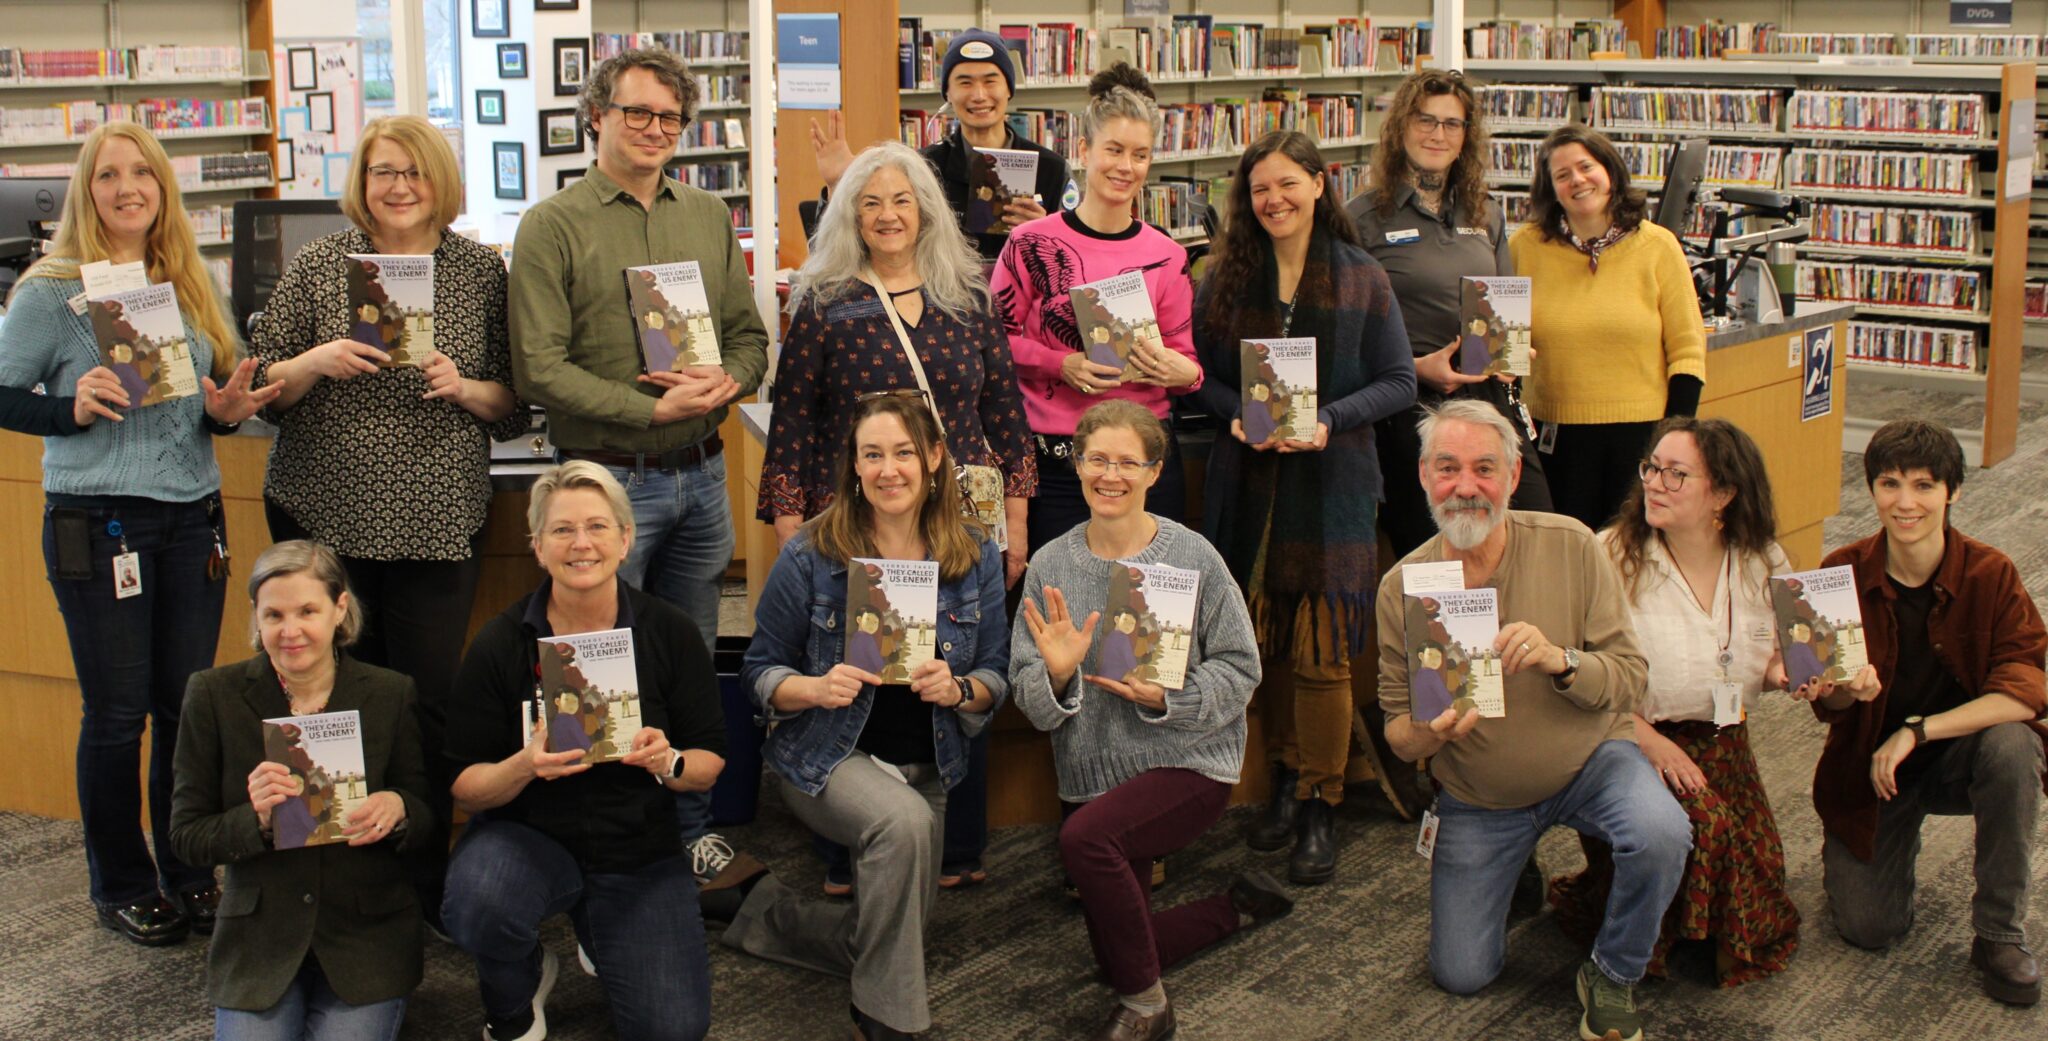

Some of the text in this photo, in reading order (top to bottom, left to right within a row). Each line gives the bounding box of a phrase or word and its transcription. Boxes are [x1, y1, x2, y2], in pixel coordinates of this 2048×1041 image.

[1966, 8, 1995, 18] DVDs
[798, 36, 818, 46] Teen
[1116, 284, 1142, 294] ENEMY
[142, 298, 172, 310] ENEMY
[1168, 576, 1194, 584] CALLED
[1826, 574, 1850, 582] CALLED
[1164, 582, 1193, 591] ENEMY
[1822, 580, 1850, 590] ENEMY
[1462, 605, 1492, 613] ENEMY
[600, 640, 628, 648] CALLED
[596, 646, 628, 656] ENEMY
[326, 722, 356, 730] CALLED
[323, 728, 356, 738] ENEMY
